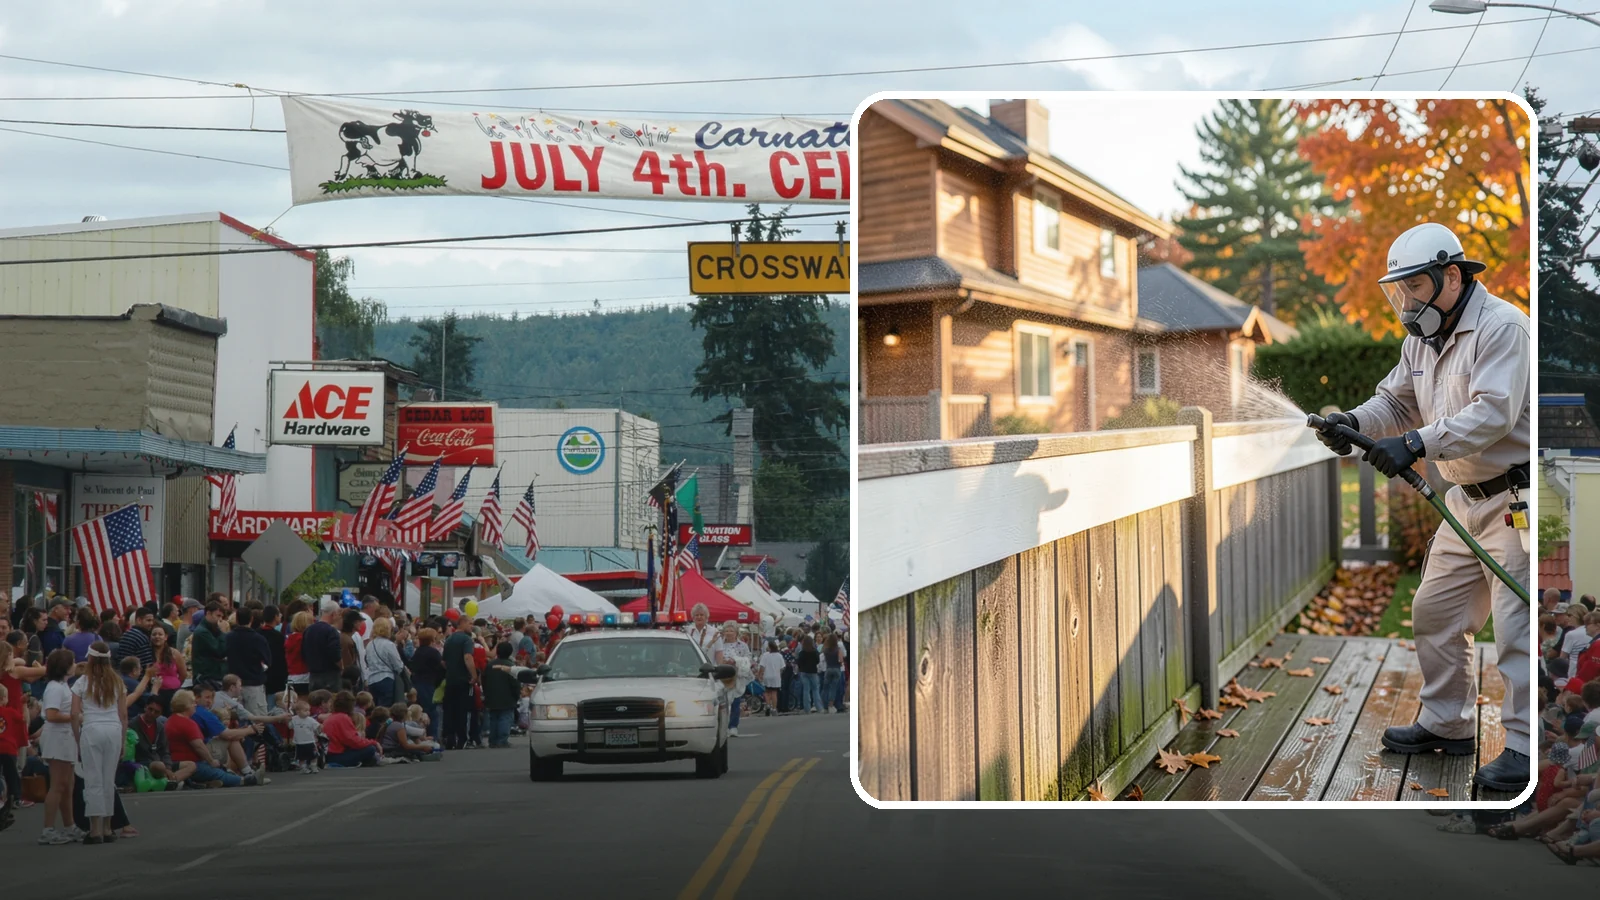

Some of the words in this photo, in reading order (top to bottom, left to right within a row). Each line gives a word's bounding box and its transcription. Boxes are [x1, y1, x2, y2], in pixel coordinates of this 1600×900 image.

[481, 141, 604, 192] JULY
[632, 150, 746, 197] 4th.
[697, 254, 850, 279] CROSSWA
[283, 380, 373, 420] ACE
[406, 409, 452, 422] CEDAR
[461, 409, 485, 422] LOG
[283, 421, 371, 436] Hardware
[353, 467, 387, 480] Simpl
[83, 485, 93, 494] St.
[95, 485, 124, 495] Vincent
[126, 486, 135, 495] de
[137, 486, 155, 495] Paul
[212, 516, 331, 535] HARDARE
[688, 526, 742, 535] CRNATION
[699, 535, 730, 543] GLASS
